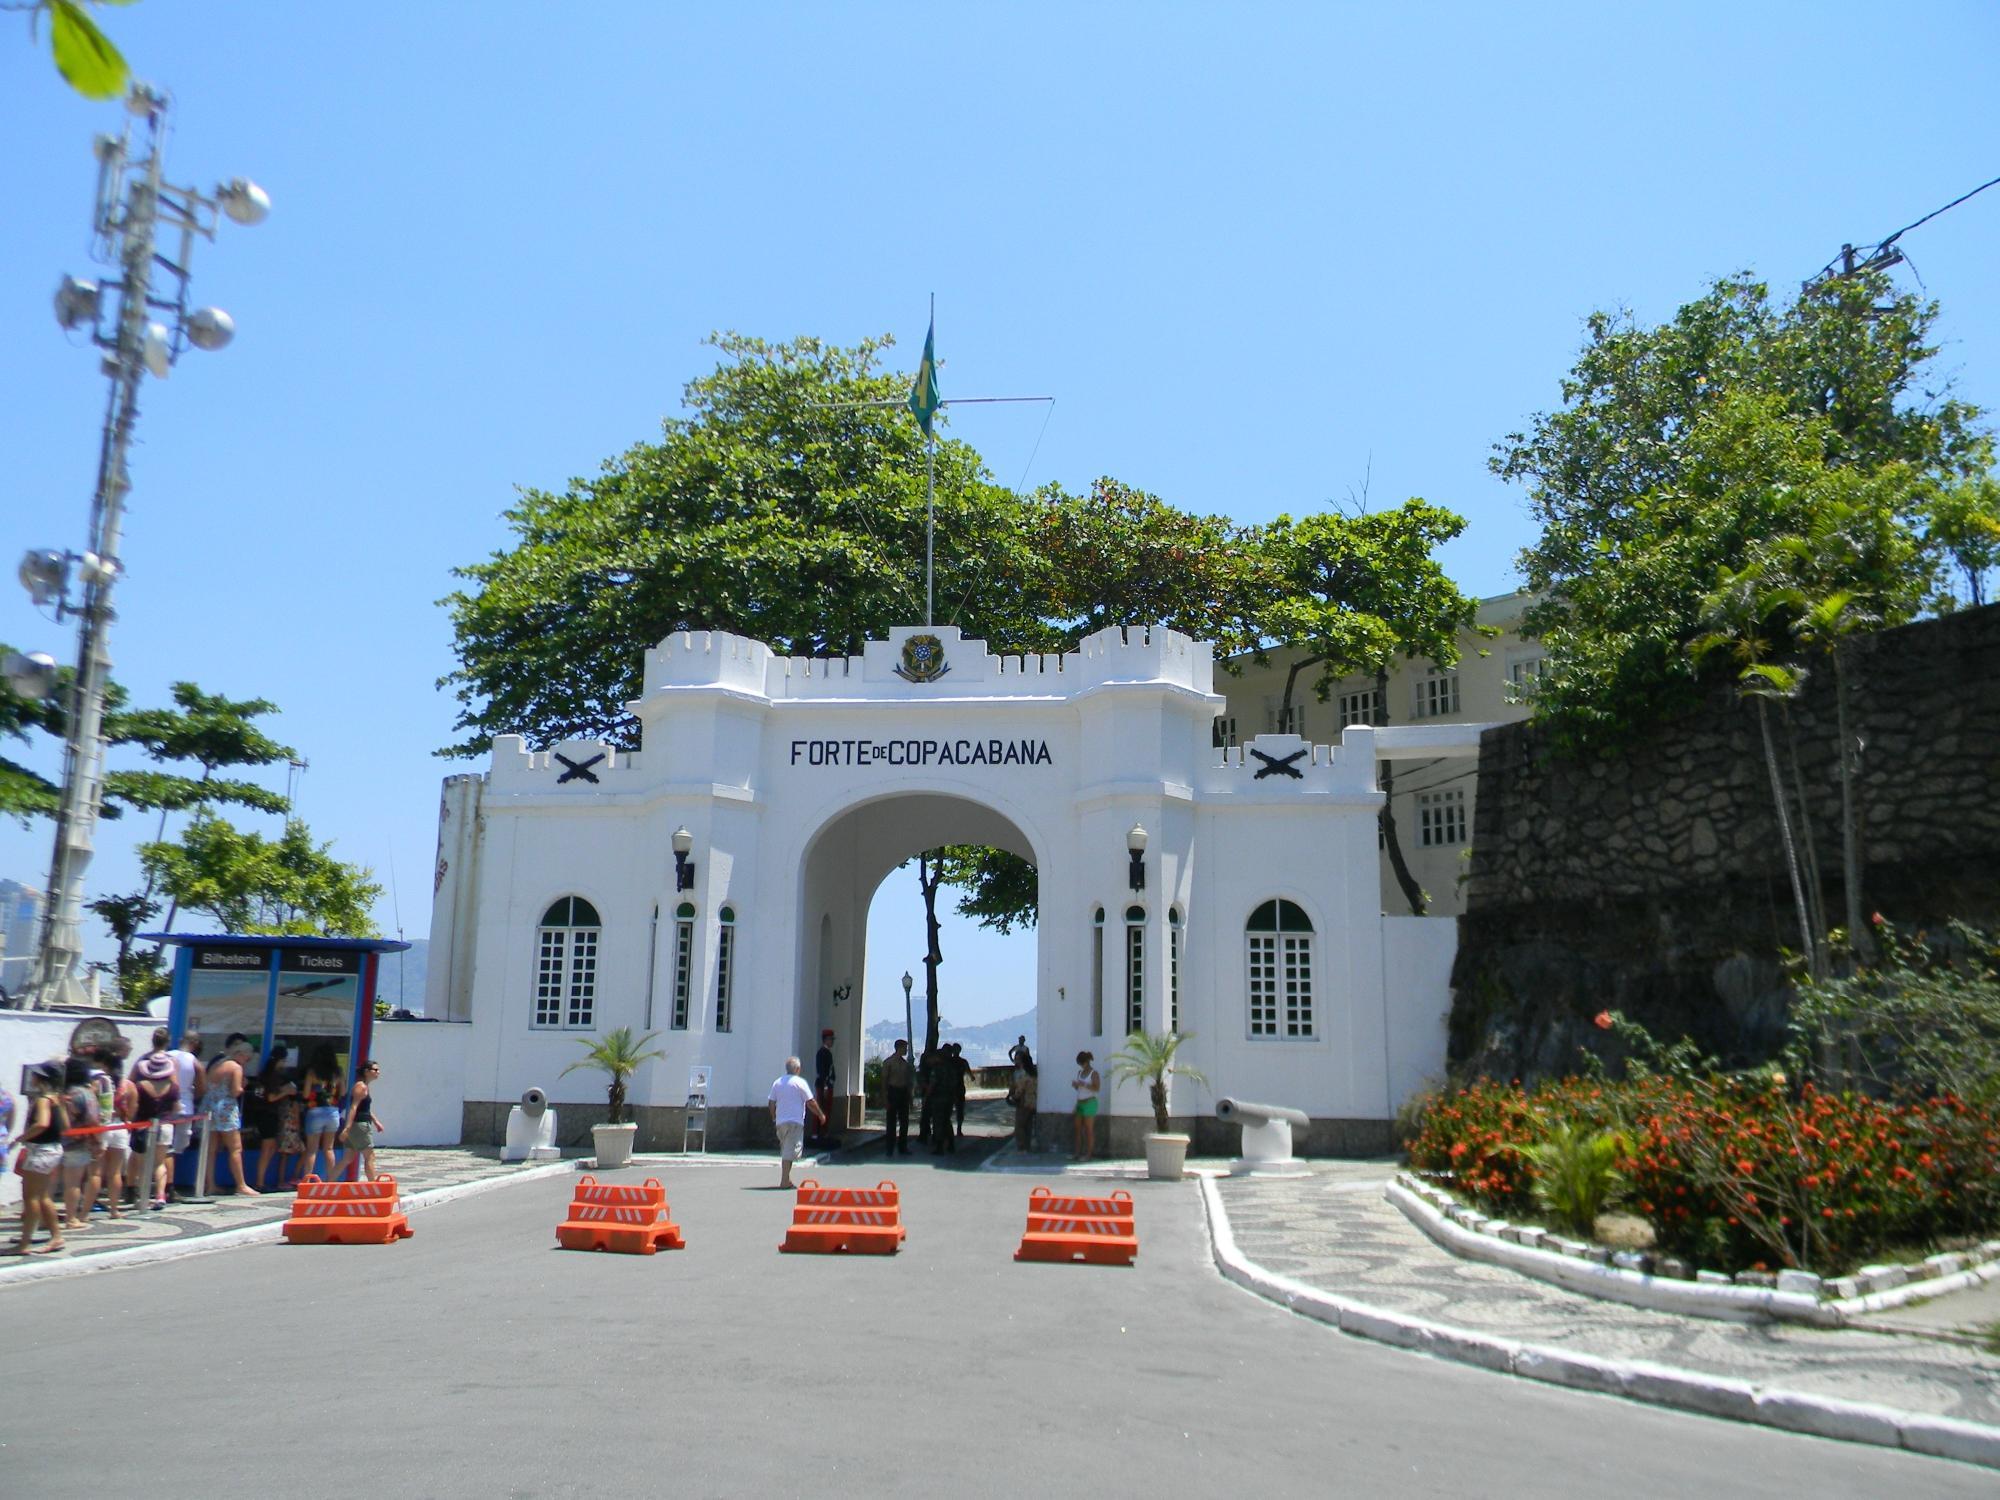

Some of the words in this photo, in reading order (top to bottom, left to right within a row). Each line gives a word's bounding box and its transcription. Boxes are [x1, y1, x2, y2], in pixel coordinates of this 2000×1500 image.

[791, 740, 872, 765] FORTE
[872, 746, 887, 759] DE
[888, 740, 1052, 765] COPACABANA
[202, 952, 261, 966] Bilheteria
[299, 955, 344, 968] Tickets
